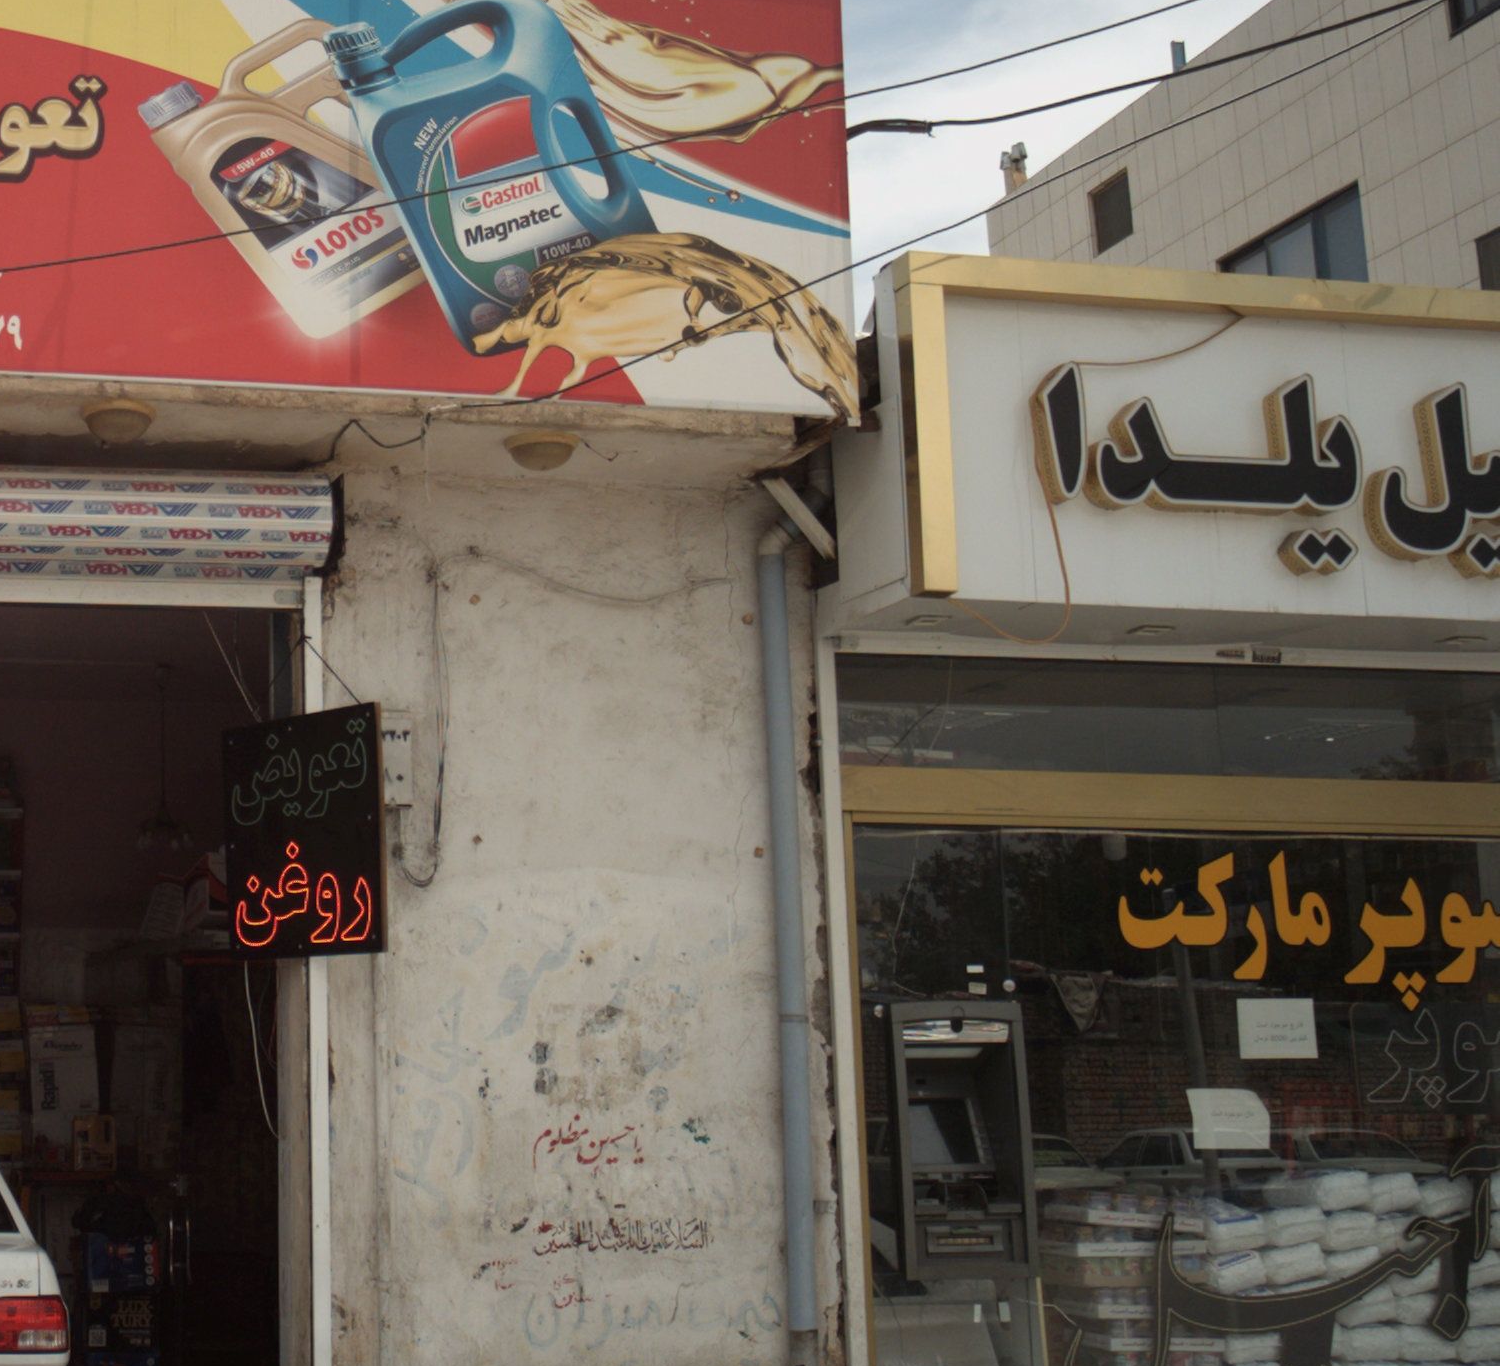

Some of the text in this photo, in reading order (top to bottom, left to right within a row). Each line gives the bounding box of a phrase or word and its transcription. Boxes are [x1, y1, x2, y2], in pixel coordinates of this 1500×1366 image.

[413, 116, 438, 151] NEW
[480, 177, 544, 211] Castrol
[318, 207, 385, 257] LOTOS
[463, 201, 564, 248] Magnatec
[540, 234, 592, 262] 10W-40
[1030, 359, 1362, 577] یلدا
[231, 718, 368, 826] تعویض
[235, 840, 375, 948] روغن
[1117, 850, 1331, 980] مارکت
[39, 1061, 59, 1111] Rapid
